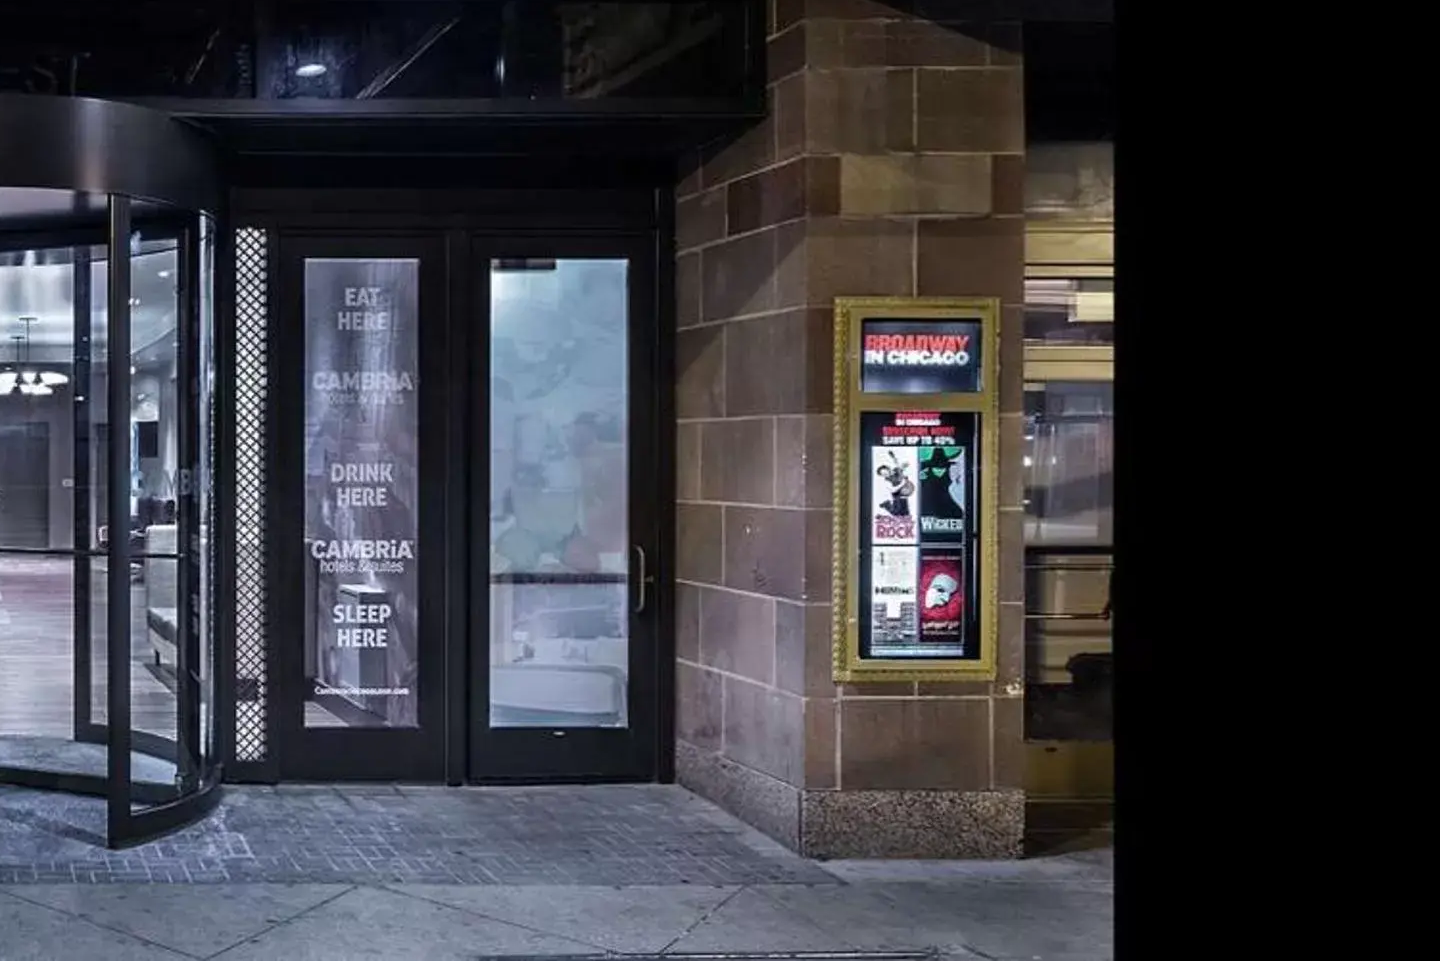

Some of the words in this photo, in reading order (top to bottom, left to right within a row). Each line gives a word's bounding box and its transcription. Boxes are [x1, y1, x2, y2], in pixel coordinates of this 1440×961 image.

[344, 287, 381, 307] EAT
[337, 311, 389, 331] HERE
[864, 334, 970, 351] BROADWAY
[864, 350, 884, 365] IN
[887, 350, 970, 366] CHICAGO
[330, 463, 393, 483] DRINK
[336, 488, 388, 507] HERE
[876, 525, 915, 539] ROCK
[332, 604, 392, 624] SLEEP
[336, 629, 388, 648] HERE
